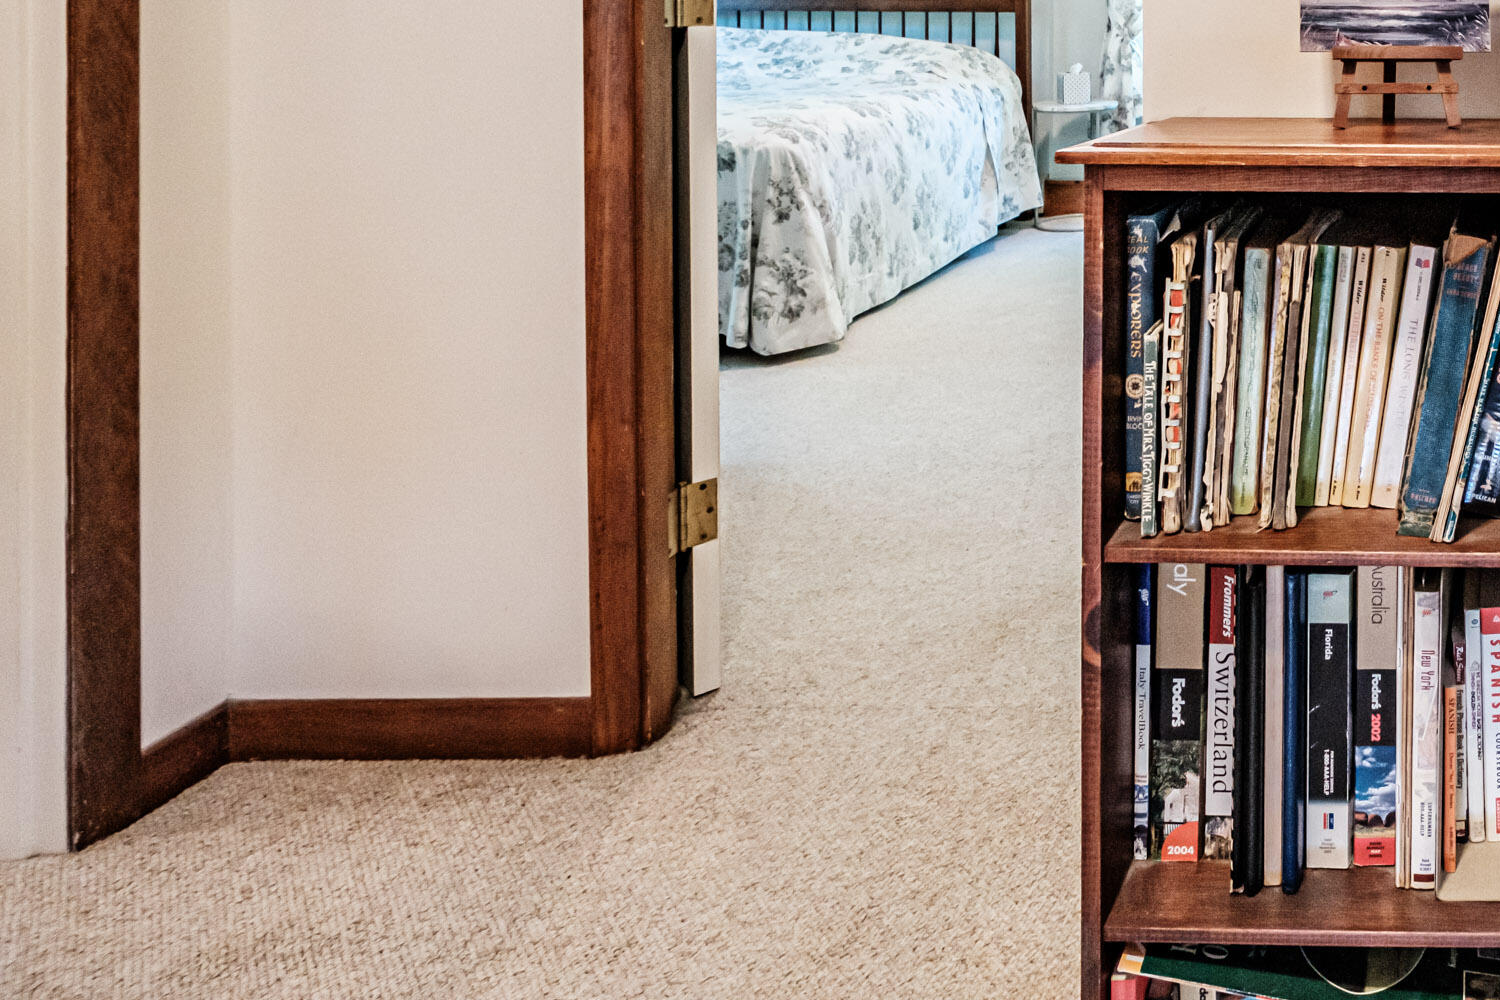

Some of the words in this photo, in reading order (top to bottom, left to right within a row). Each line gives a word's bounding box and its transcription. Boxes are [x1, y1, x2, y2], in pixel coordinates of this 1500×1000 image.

[1355, 280, 1364, 305] Wilder
[1407, 319, 1419, 344] THE
[1144, 360, 1157, 382] THE
[1402, 347, 1416, 380] LONG
[1144, 382, 1157, 408] TALE
[1143, 412, 1154, 428] OF
[1472, 493, 1497, 504] PELICAN
[1166, 563, 1197, 596] aly
[1222, 574, 1235, 638] Frommer's
[1324, 628, 1334, 660] Florida
[1420, 649, 1436, 668] New
[1137, 667, 1147, 688] Italy
[1420, 670, 1435, 691] York
[1171, 677, 1186, 728] Fodor's
[1371, 673, 1382, 710] Fodor's
[1456, 689, 1465, 710] French
[1138, 693, 1147, 751] TravelBook
[1212, 651, 1235, 794] Switzerland
[1370, 713, 1382, 743] 2002
[1447, 697, 1455, 735] SPANISH
[1456, 712, 1465, 733] Phrase
[1456, 734, 1465, 750] Book
[1456, 758, 1465, 790] Dictionary
[1167, 846, 1195, 855] 2004
